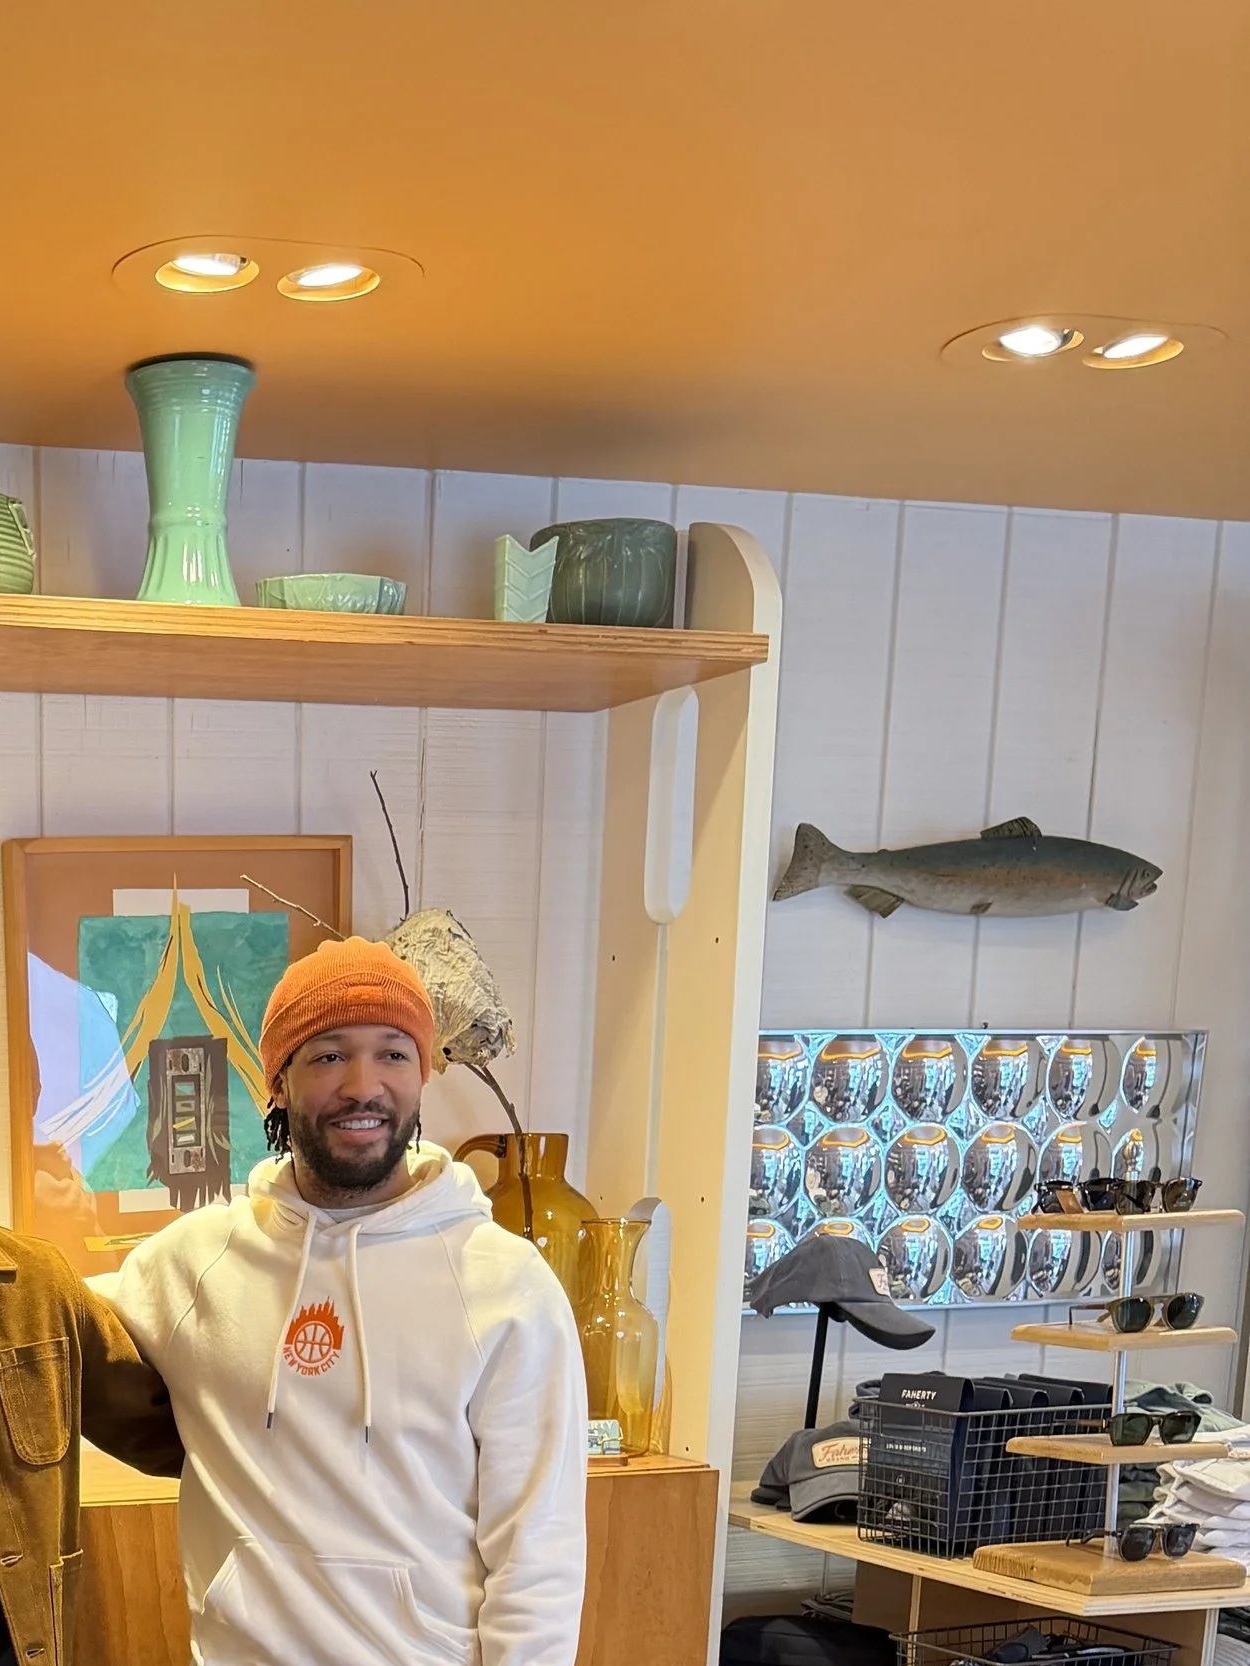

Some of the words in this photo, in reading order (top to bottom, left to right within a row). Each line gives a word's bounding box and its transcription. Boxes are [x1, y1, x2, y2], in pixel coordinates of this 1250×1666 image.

[282, 1346, 298, 1367] NEW
[296, 1363, 321, 1376] YORK
[320, 1351, 340, 1372] CITY
[901, 1389, 937, 1400] FAHERTY
